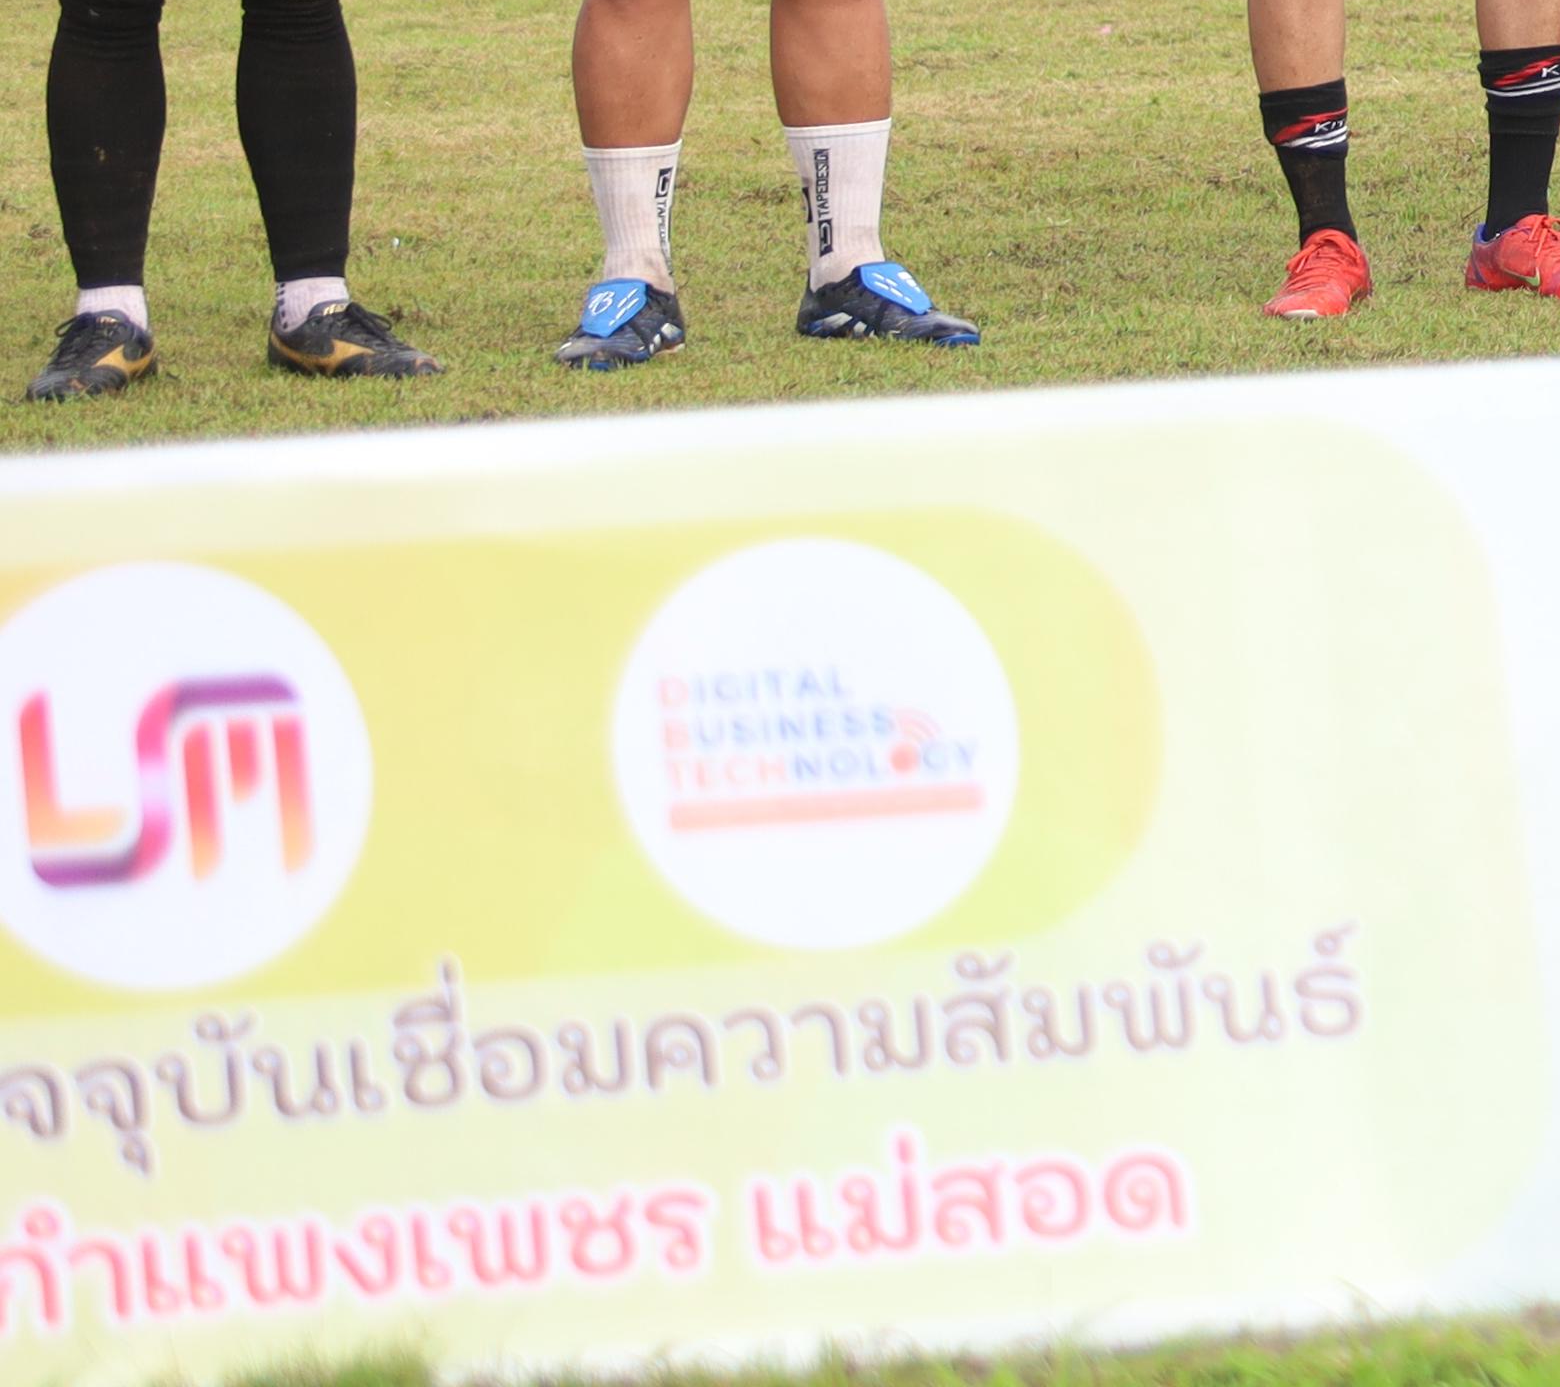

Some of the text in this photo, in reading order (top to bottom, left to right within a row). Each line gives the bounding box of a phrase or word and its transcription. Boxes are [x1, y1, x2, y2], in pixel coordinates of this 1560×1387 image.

[813, 148, 831, 221] TAPEDESIGN
[660, 665, 852, 708] DIGITAL
[663, 706, 896, 751] BUSINESS
[750, 1132, 1188, 1262] แม่สอด
